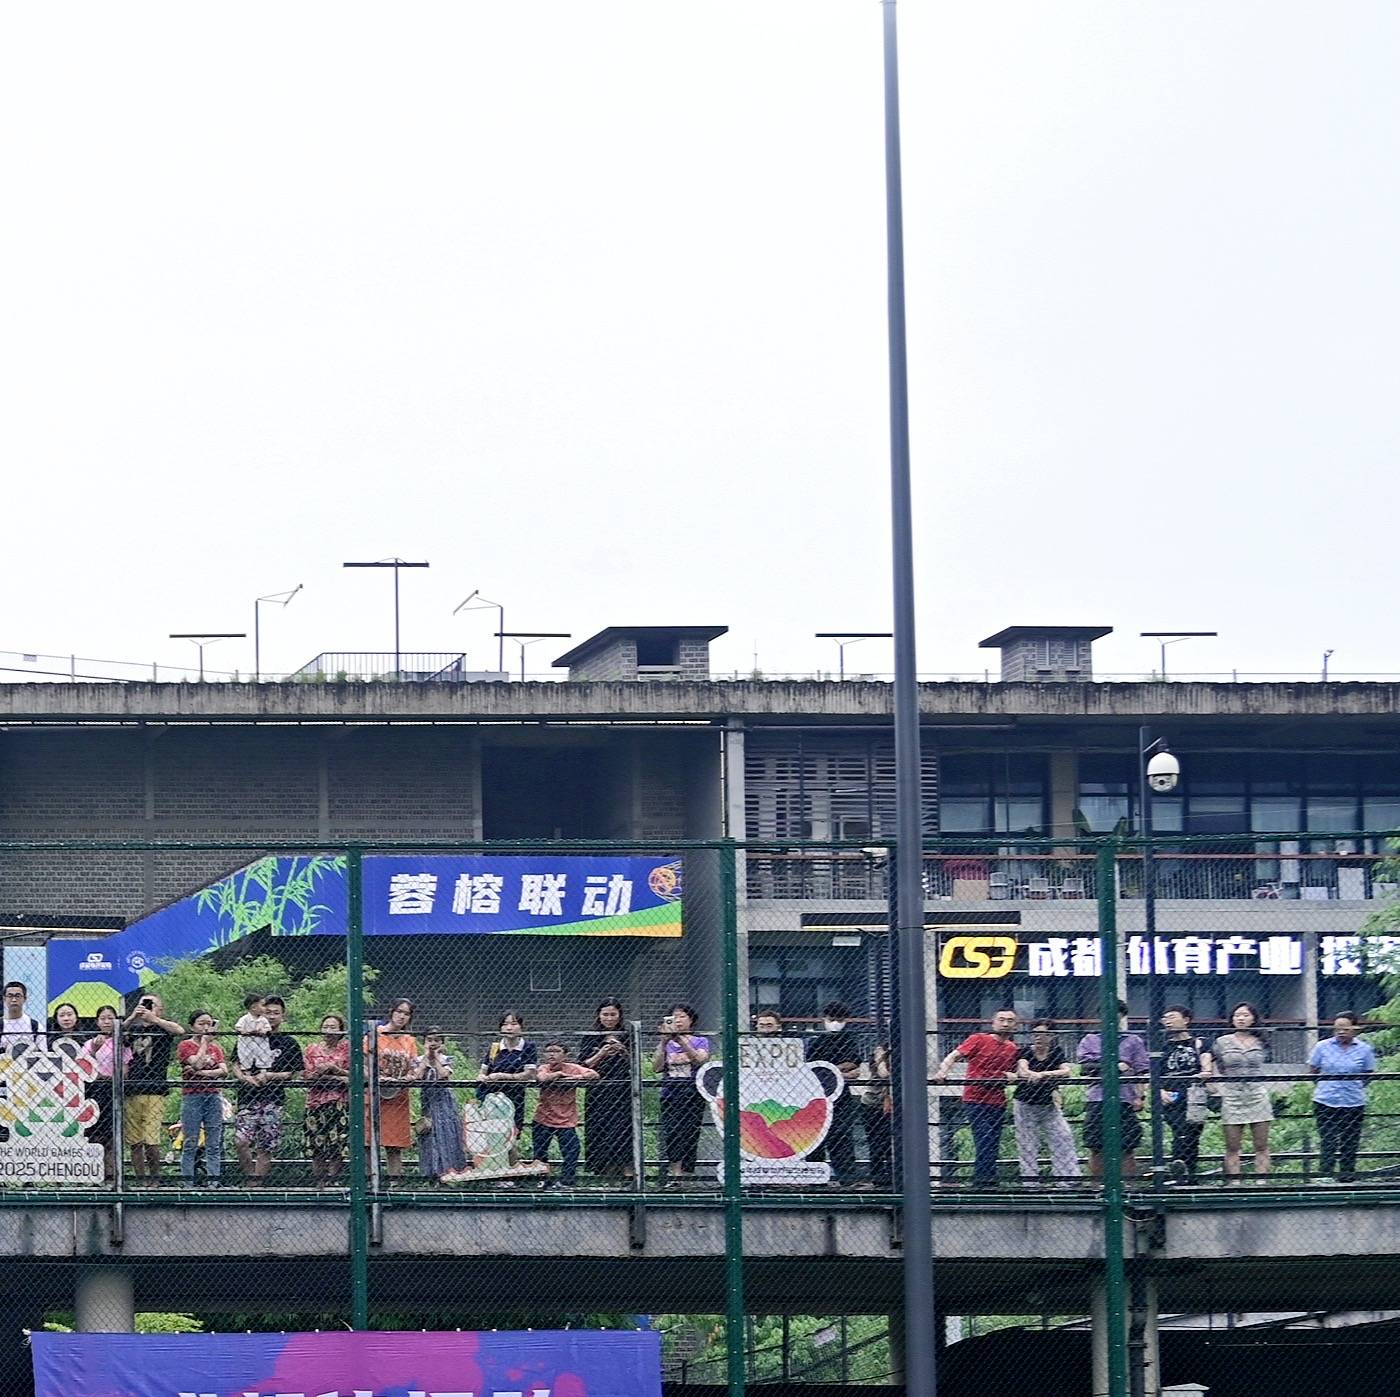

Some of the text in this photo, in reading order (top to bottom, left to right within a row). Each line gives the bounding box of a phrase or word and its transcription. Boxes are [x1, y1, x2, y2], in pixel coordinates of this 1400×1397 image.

[388, 873, 633, 917] 蓉榕联动
[15, 1147, 49, 1158] WORLD
[51, 1147, 84, 1158] GAMES
[38, 1162, 99, 1177] CHENGDU
